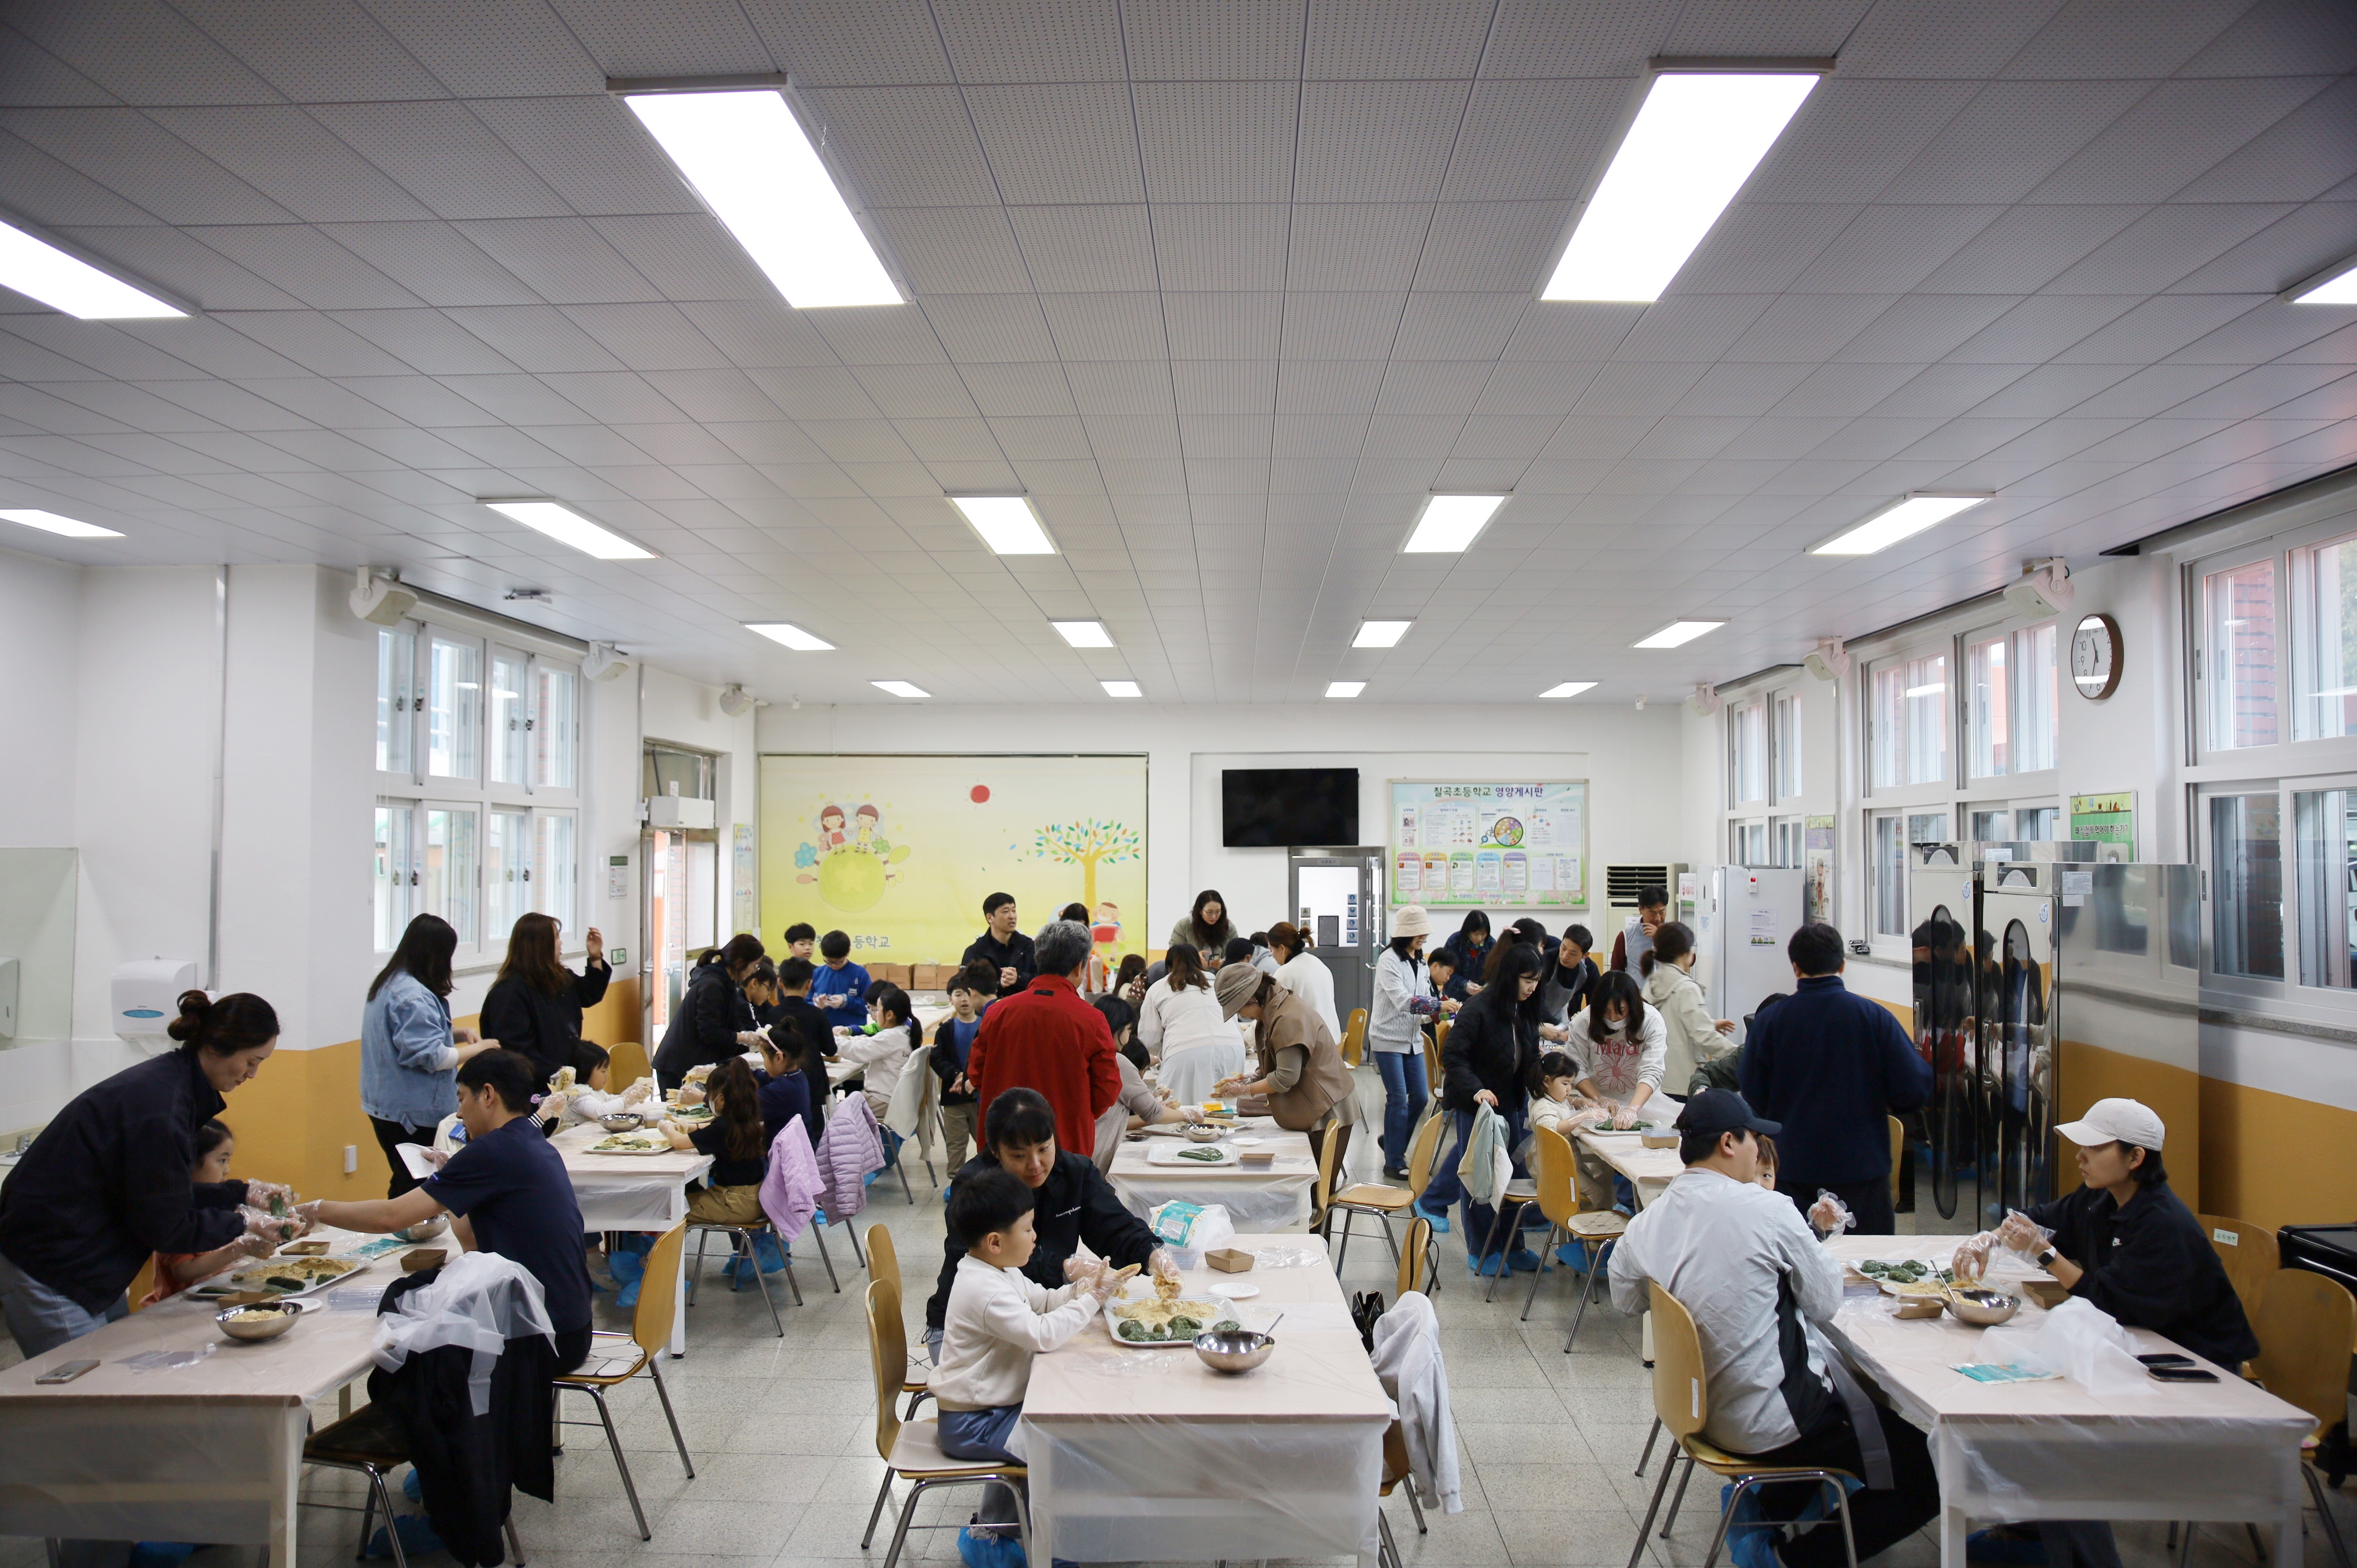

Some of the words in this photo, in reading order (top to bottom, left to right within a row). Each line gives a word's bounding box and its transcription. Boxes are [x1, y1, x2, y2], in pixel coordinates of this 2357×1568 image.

[2081, 641, 2086, 651] 10
[2081, 655, 2084, 666] 9
[1433, 786, 1491, 798] 칠곡초등학교
[1495, 786, 1543, 798] 영양게시판
[2081, 825, 2094, 837] 싱겁게
[2095, 825, 2109, 836] 먹어야
[2110, 824, 2128, 836] 하는가?
